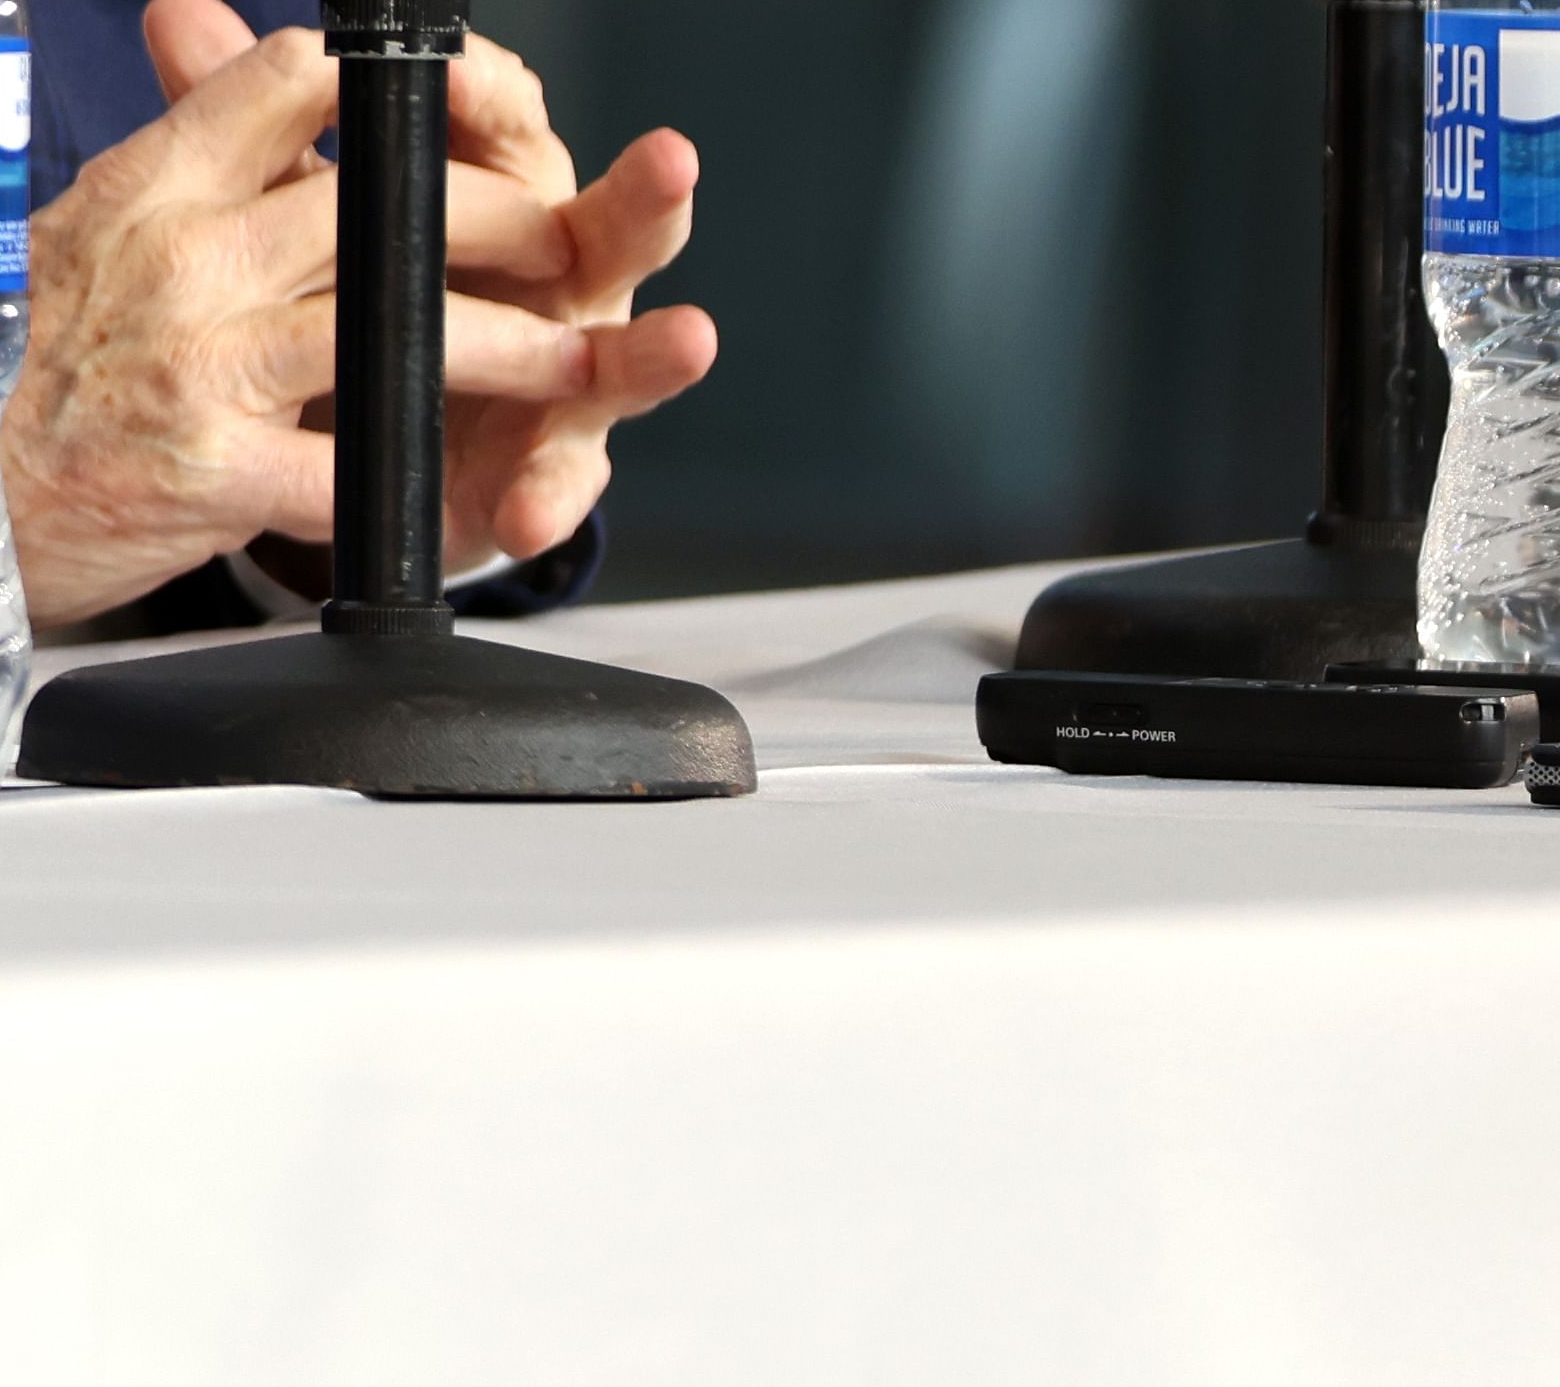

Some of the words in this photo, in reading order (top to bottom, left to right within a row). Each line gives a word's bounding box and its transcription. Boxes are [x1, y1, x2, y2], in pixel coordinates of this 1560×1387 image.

[1425, 41, 1485, 118] DEJA
[1424, 125, 1485, 201] BLUE
[1056, 726, 1090, 738] HOLD
[1132, 729, 1176, 742] POWER
